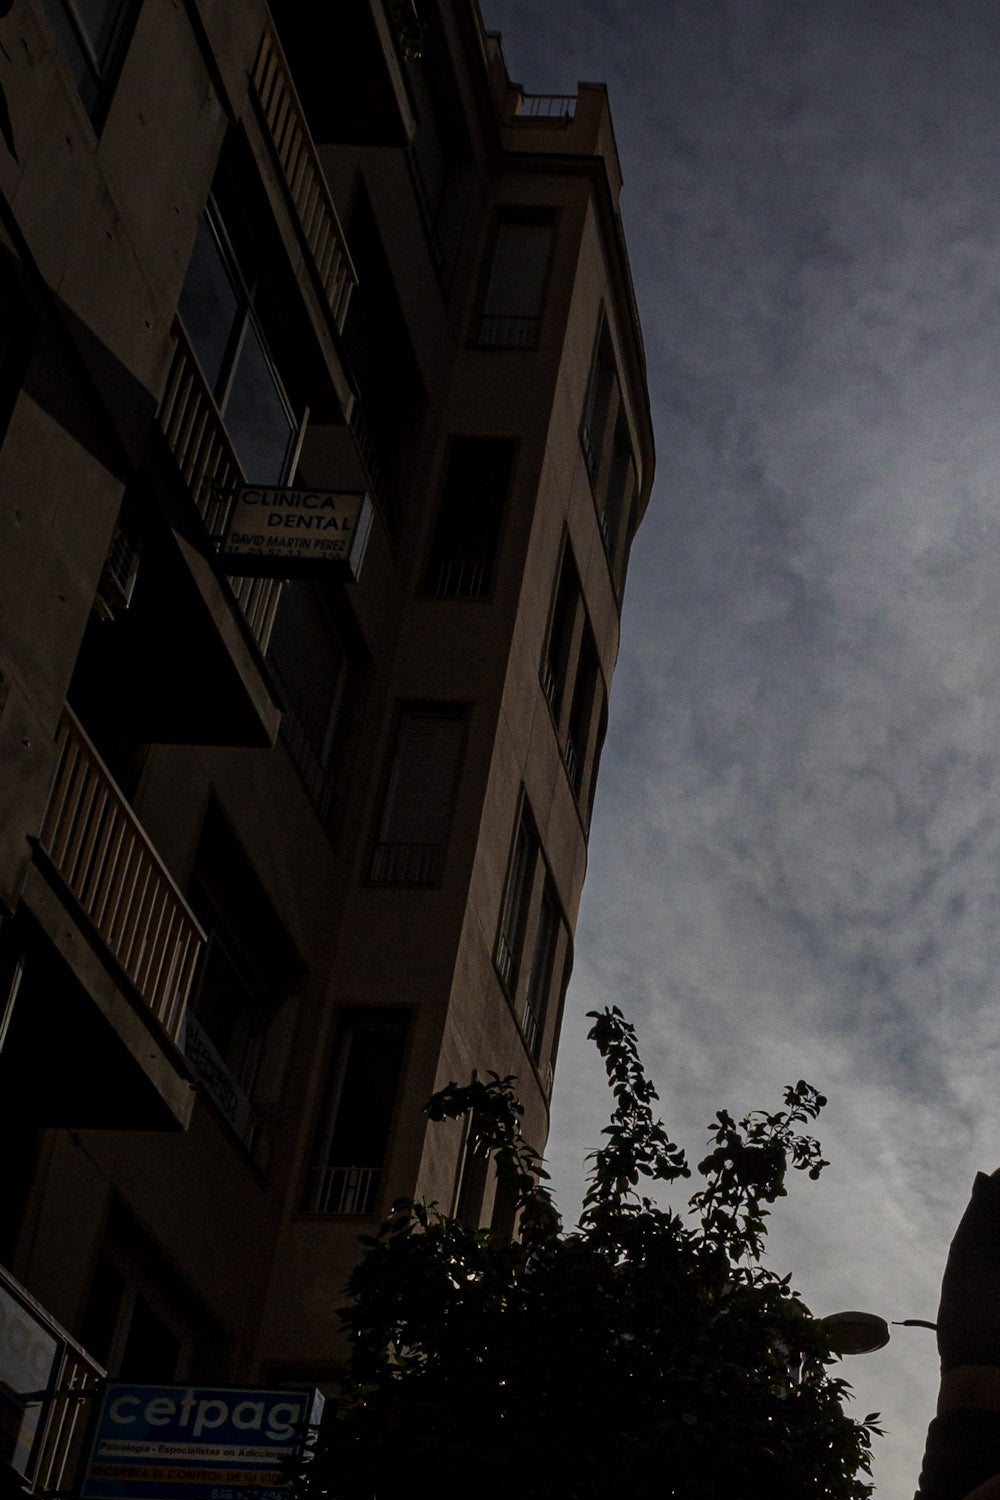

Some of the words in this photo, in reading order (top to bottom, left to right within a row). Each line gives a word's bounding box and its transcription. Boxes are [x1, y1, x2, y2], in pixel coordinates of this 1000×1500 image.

[242, 490, 336, 510] CLINICA
[267, 513, 352, 531] DENTAL
[231, 532, 264, 546] DAVID
[266, 535, 312, 549] MARTIN
[313, 538, 346, 551] PEREZ
[108, 1389, 302, 1442] cetpag
[157, 1445, 221, 1458] Especialistas
[223, 1449, 236, 1457] en
[89, 1464, 150, 1478] RECUPERA
[152, 1468, 164, 1479] EL
[167, 1468, 222, 1481] CONTROL
[226, 1471, 241, 1482] DE
[242, 1472, 258, 1483] TU
